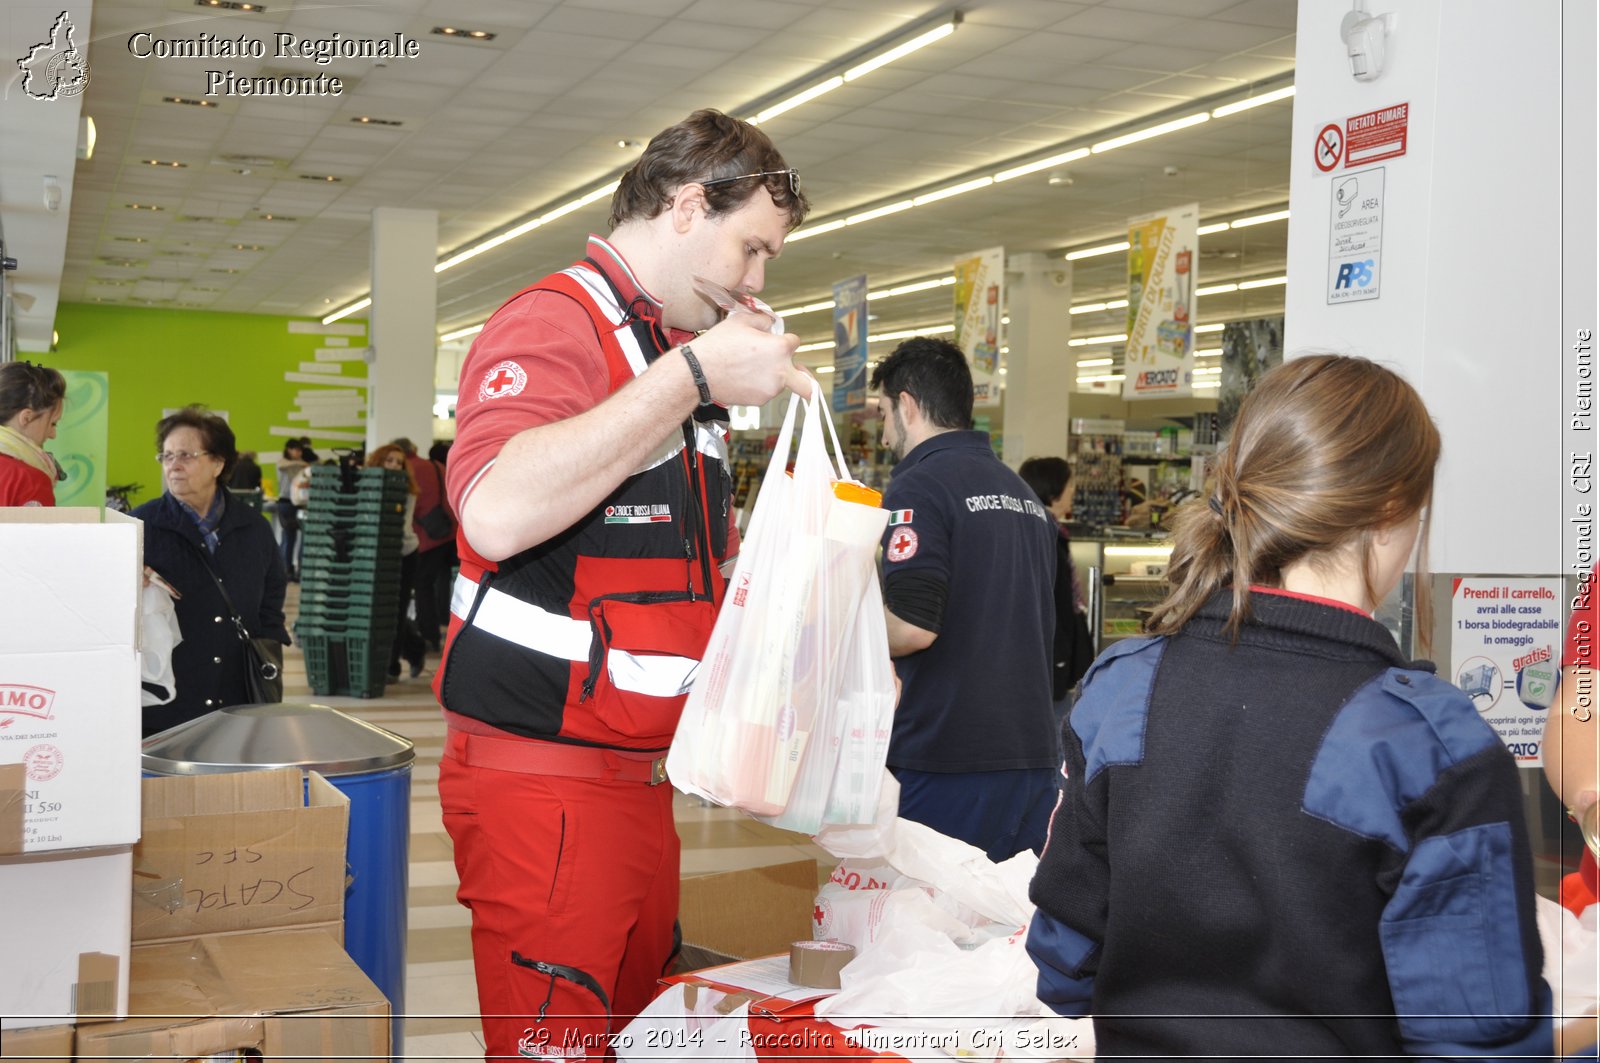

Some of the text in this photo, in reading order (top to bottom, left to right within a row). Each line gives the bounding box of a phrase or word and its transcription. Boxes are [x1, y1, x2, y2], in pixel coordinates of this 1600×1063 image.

[1348, 105, 1407, 132] VIETATO FUMARE
[1361, 198, 1379, 211] AREA
[1335, 259, 1376, 290] RPS
[1128, 307, 1150, 362] OFFERTE
[1137, 370, 1178, 386] MERCATO
[614, 504, 633, 516] CROCE
[633, 504, 651, 516] ROSSA
[965, 495, 1001, 512] CROCE
[1001, 495, 1024, 514] ROSSA
[1463, 587, 1556, 600] Prendi il carrello,
[1477, 604, 1542, 614] avrai alle casse
[1457, 620, 1463, 629] 1
[1465, 620, 1490, 630] borsa
[1484, 635, 1534, 646] in omaggio
[1512, 644, 1552, 672] gratis!
[1518, 716, 1533, 726] ogni
[30, 732, 58, 740] MULINI
[1508, 728, 1519, 737] più
[1521, 728, 1542, 736] facile!
[37, 801, 62, 814] 550
